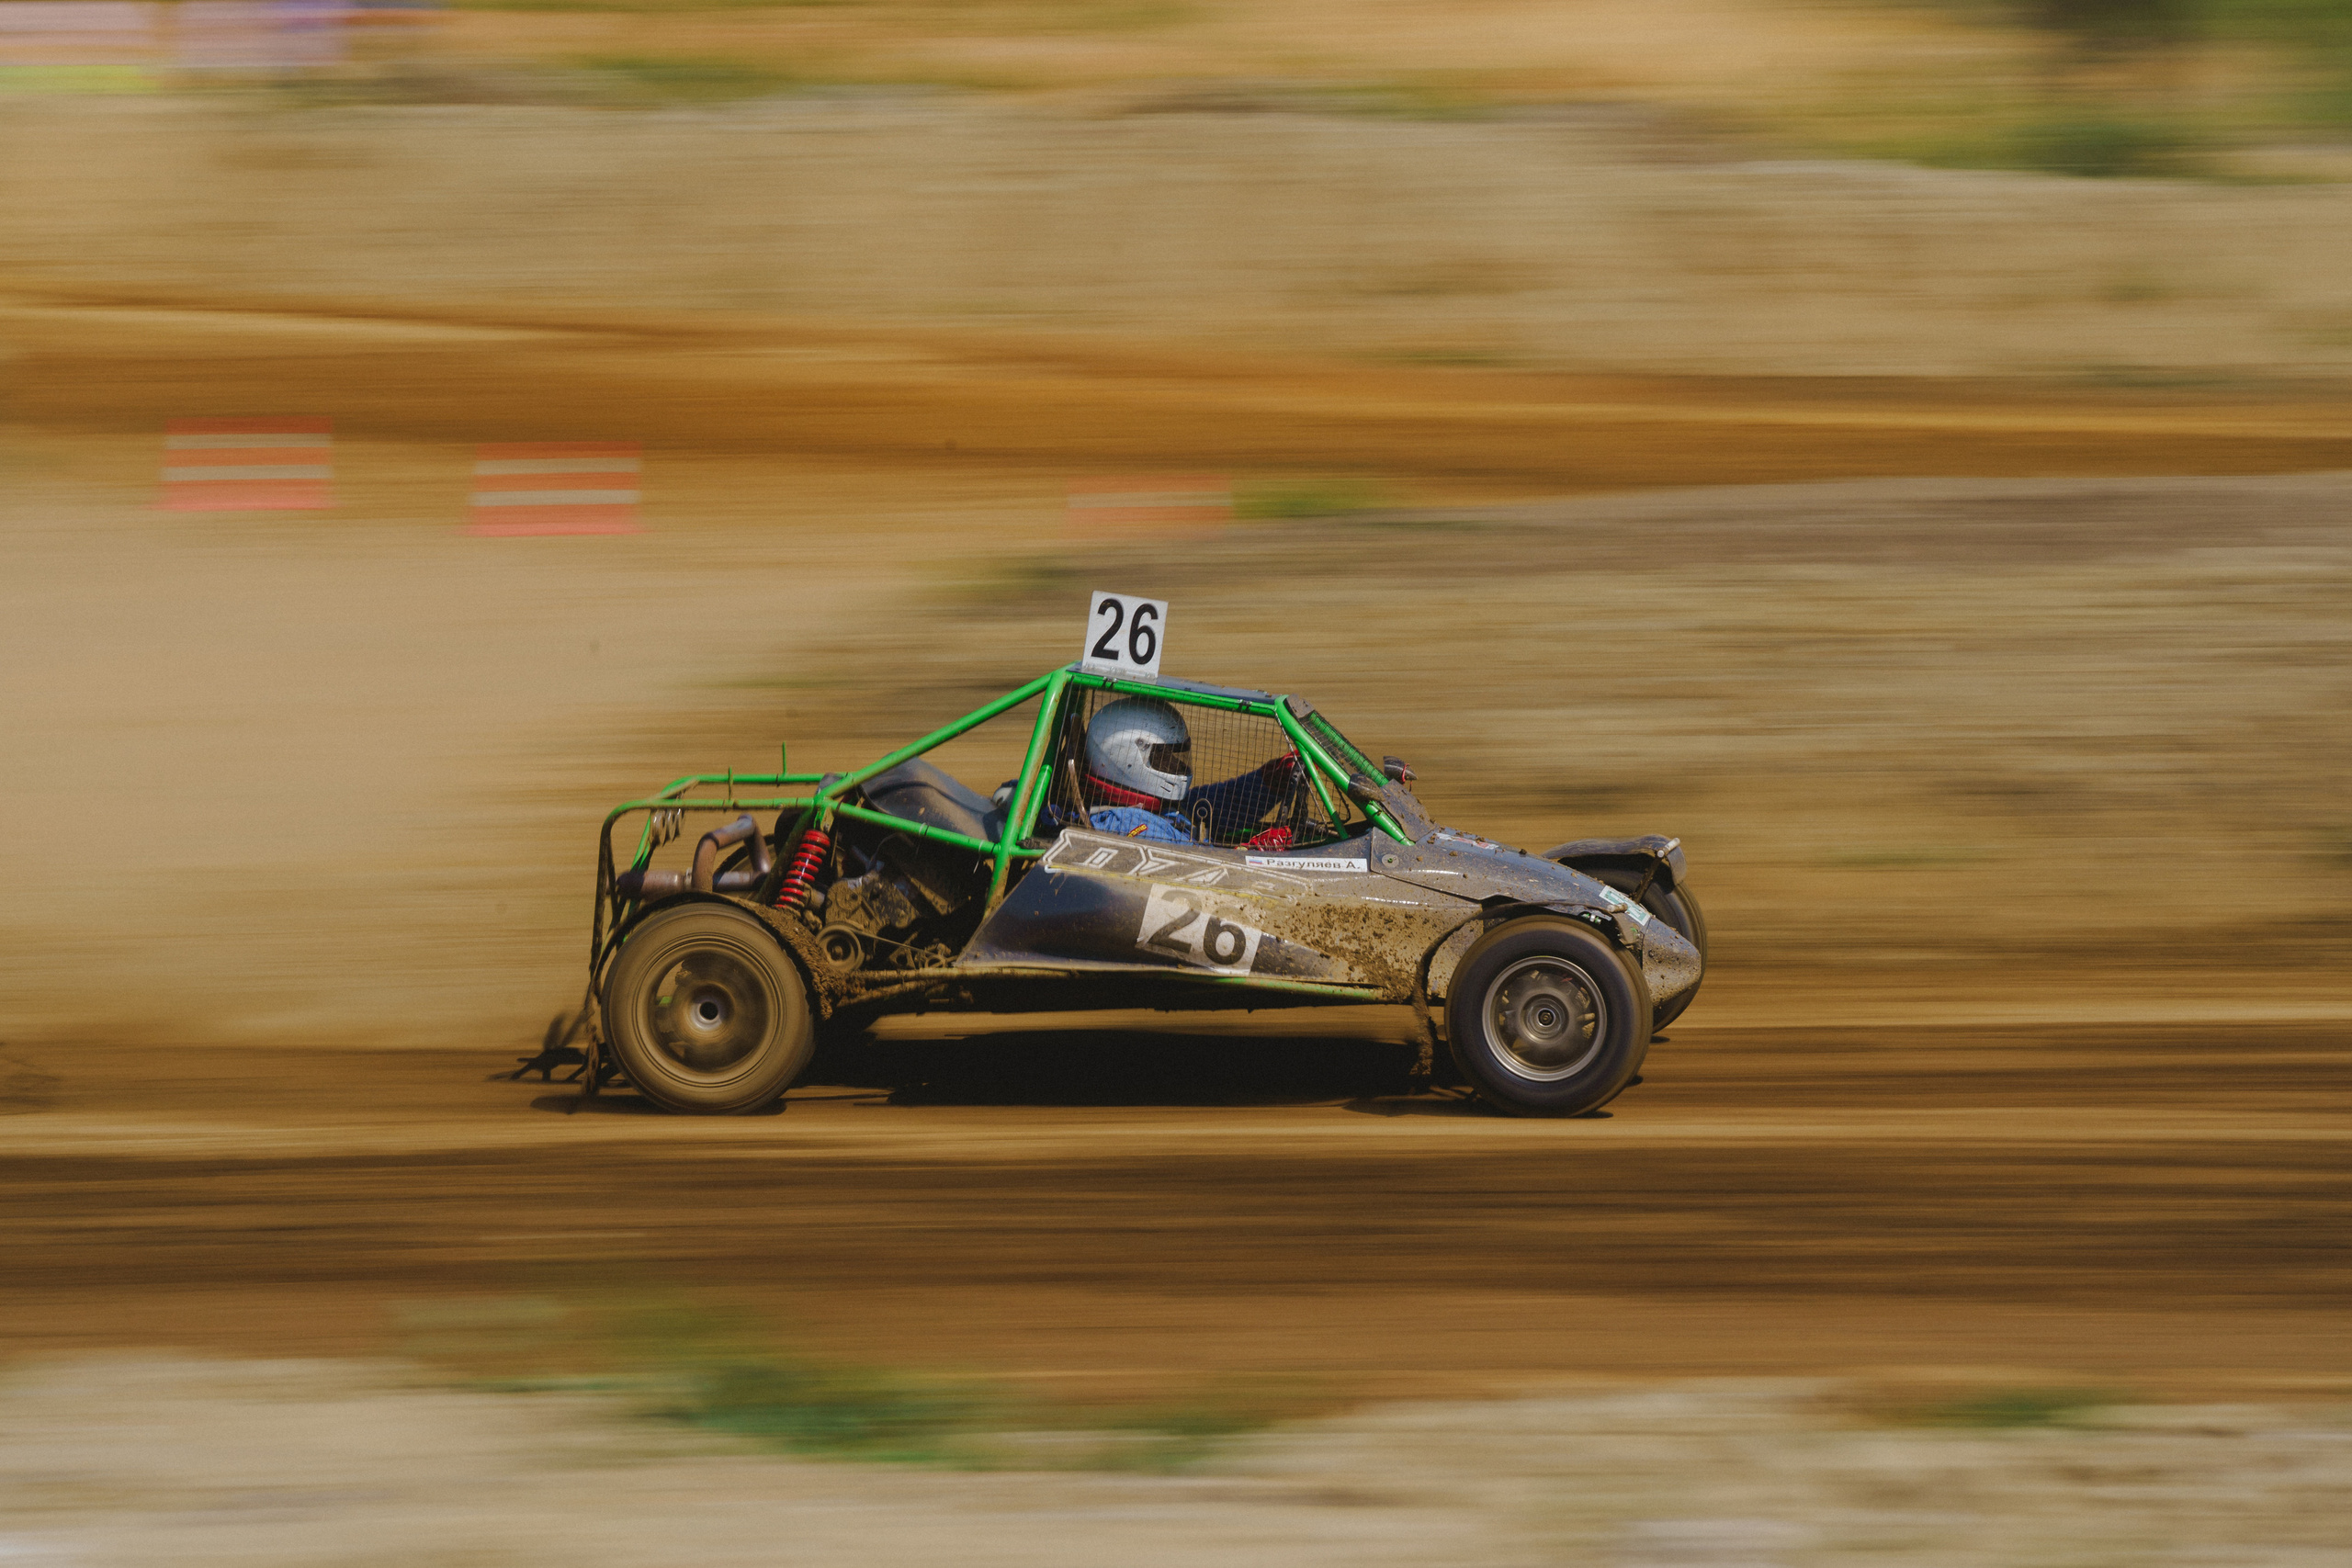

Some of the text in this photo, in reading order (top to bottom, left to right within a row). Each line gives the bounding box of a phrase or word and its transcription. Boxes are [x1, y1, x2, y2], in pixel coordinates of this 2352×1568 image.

[1091, 598, 1159, 666] 26
[1266, 858, 1341, 869] Разгуляев
[1147, 889, 1247, 965] 26
